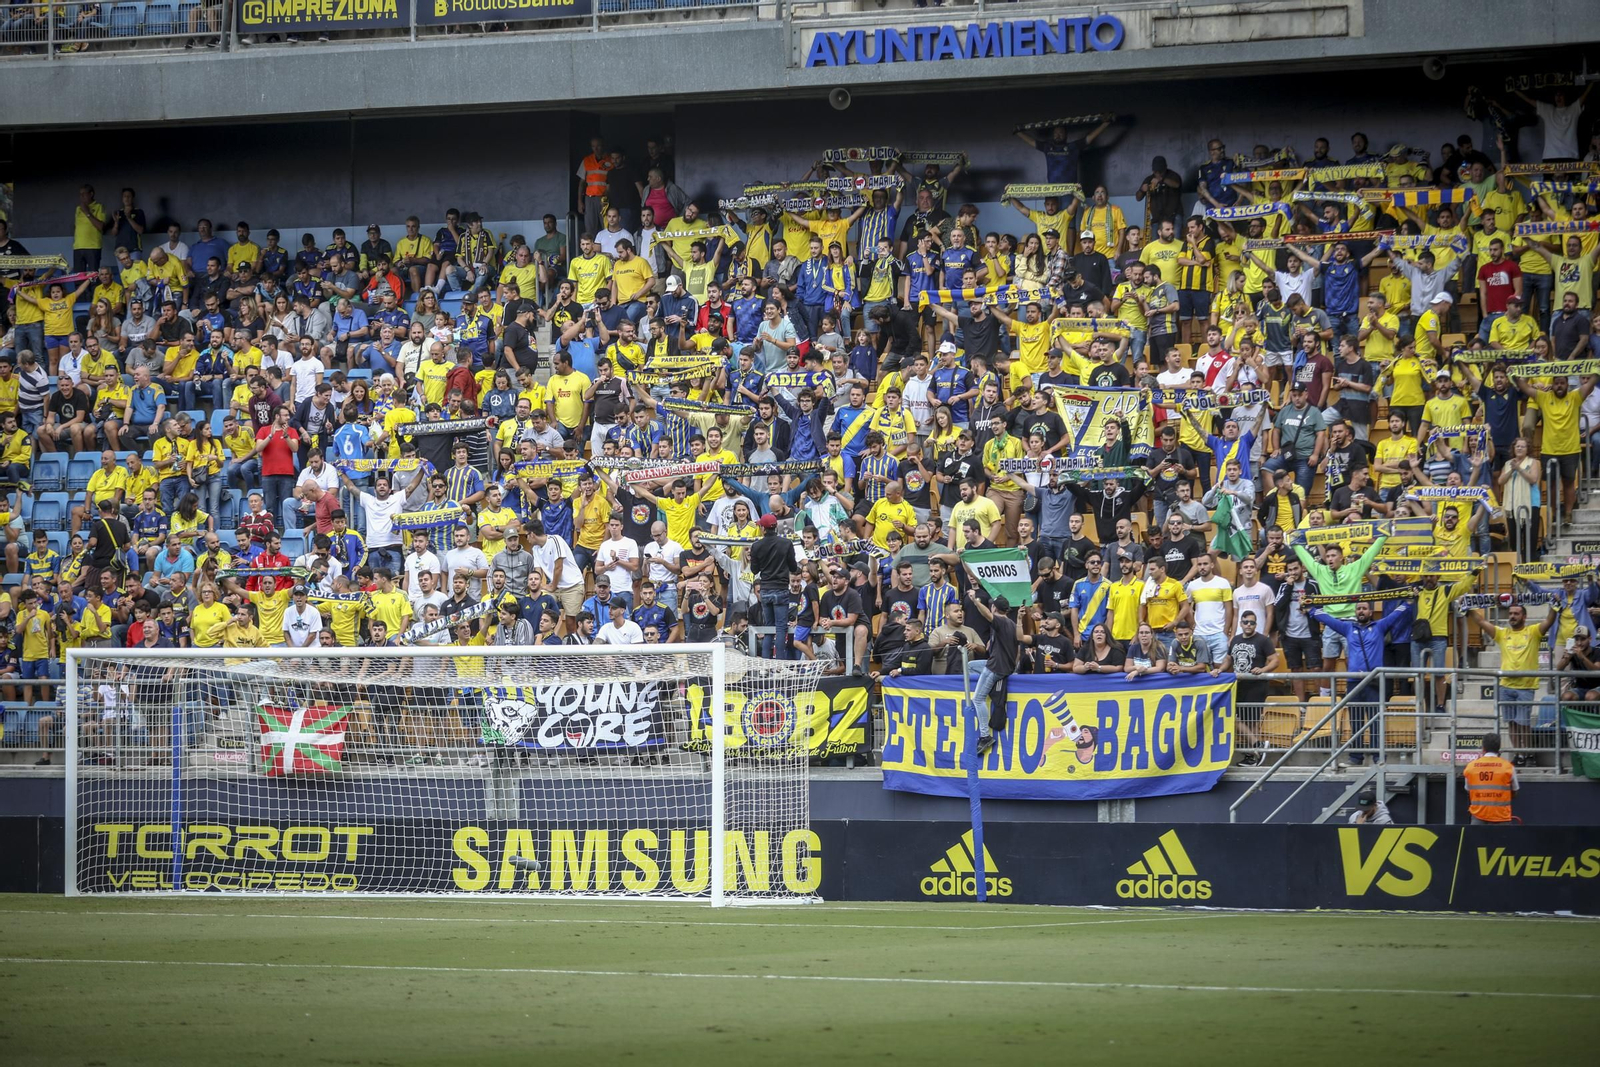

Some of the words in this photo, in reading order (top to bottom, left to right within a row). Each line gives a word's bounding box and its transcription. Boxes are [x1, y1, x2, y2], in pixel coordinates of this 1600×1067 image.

[267, 15, 333, 24] GIGANTO
[348, 12, 399, 21] GRAFIA
[805, 14, 1125, 68] AYUNTAMIENTO
[343, 436, 354, 455] 6
[626, 466, 671, 482] KOMANDO
[679, 461, 718, 475] KRIPTON
[1055, 457, 1099, 471] AMARILLAS
[977, 564, 1018, 578] BORNOS
[882, 693, 1047, 775] ETENO
[1093, 689, 1233, 773] BAGUE
[1453, 737, 1483, 748] ruzca
[1442, 752, 1480, 763] Crucampo
[1479, 771, 1494, 782] 067
[95, 824, 374, 861] TORROT
[452, 826, 822, 894] SAMSUNG
[1337, 827, 1439, 897] VS
[106, 870, 358, 891] VELOCIPEDO
[920, 871, 1013, 897] adidas
[1115, 873, 1213, 900] adidas
